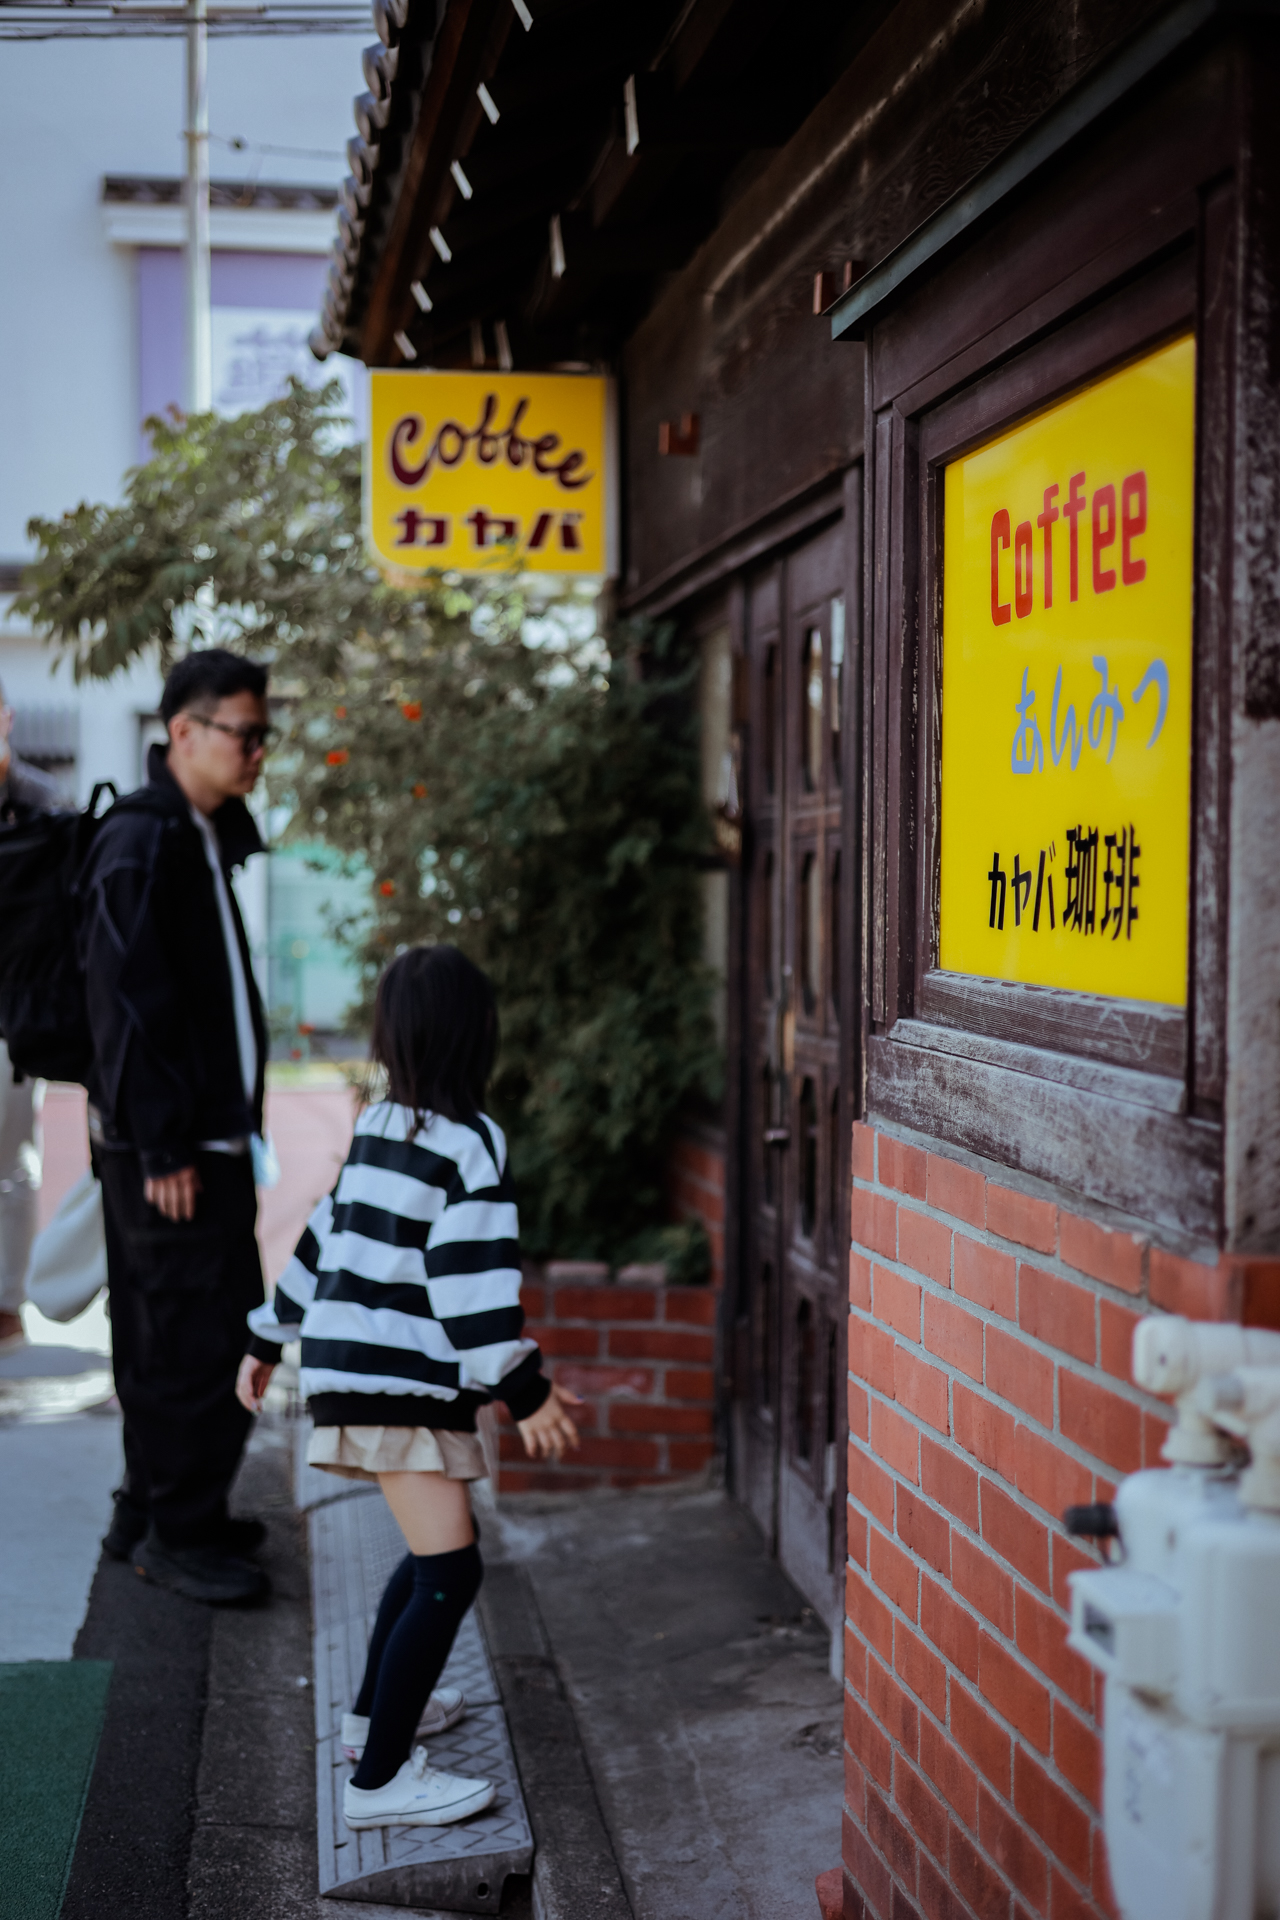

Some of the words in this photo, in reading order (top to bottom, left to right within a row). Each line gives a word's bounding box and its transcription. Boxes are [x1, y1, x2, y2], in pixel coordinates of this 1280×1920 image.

[390, 393, 596, 489] Coffee
[394, 509, 584, 550] カヤバ
[990, 470, 1149, 627] Coffee
[1010, 655, 1170, 775] あんみつ
[987, 823, 1142, 941] カヤバ珈琲
